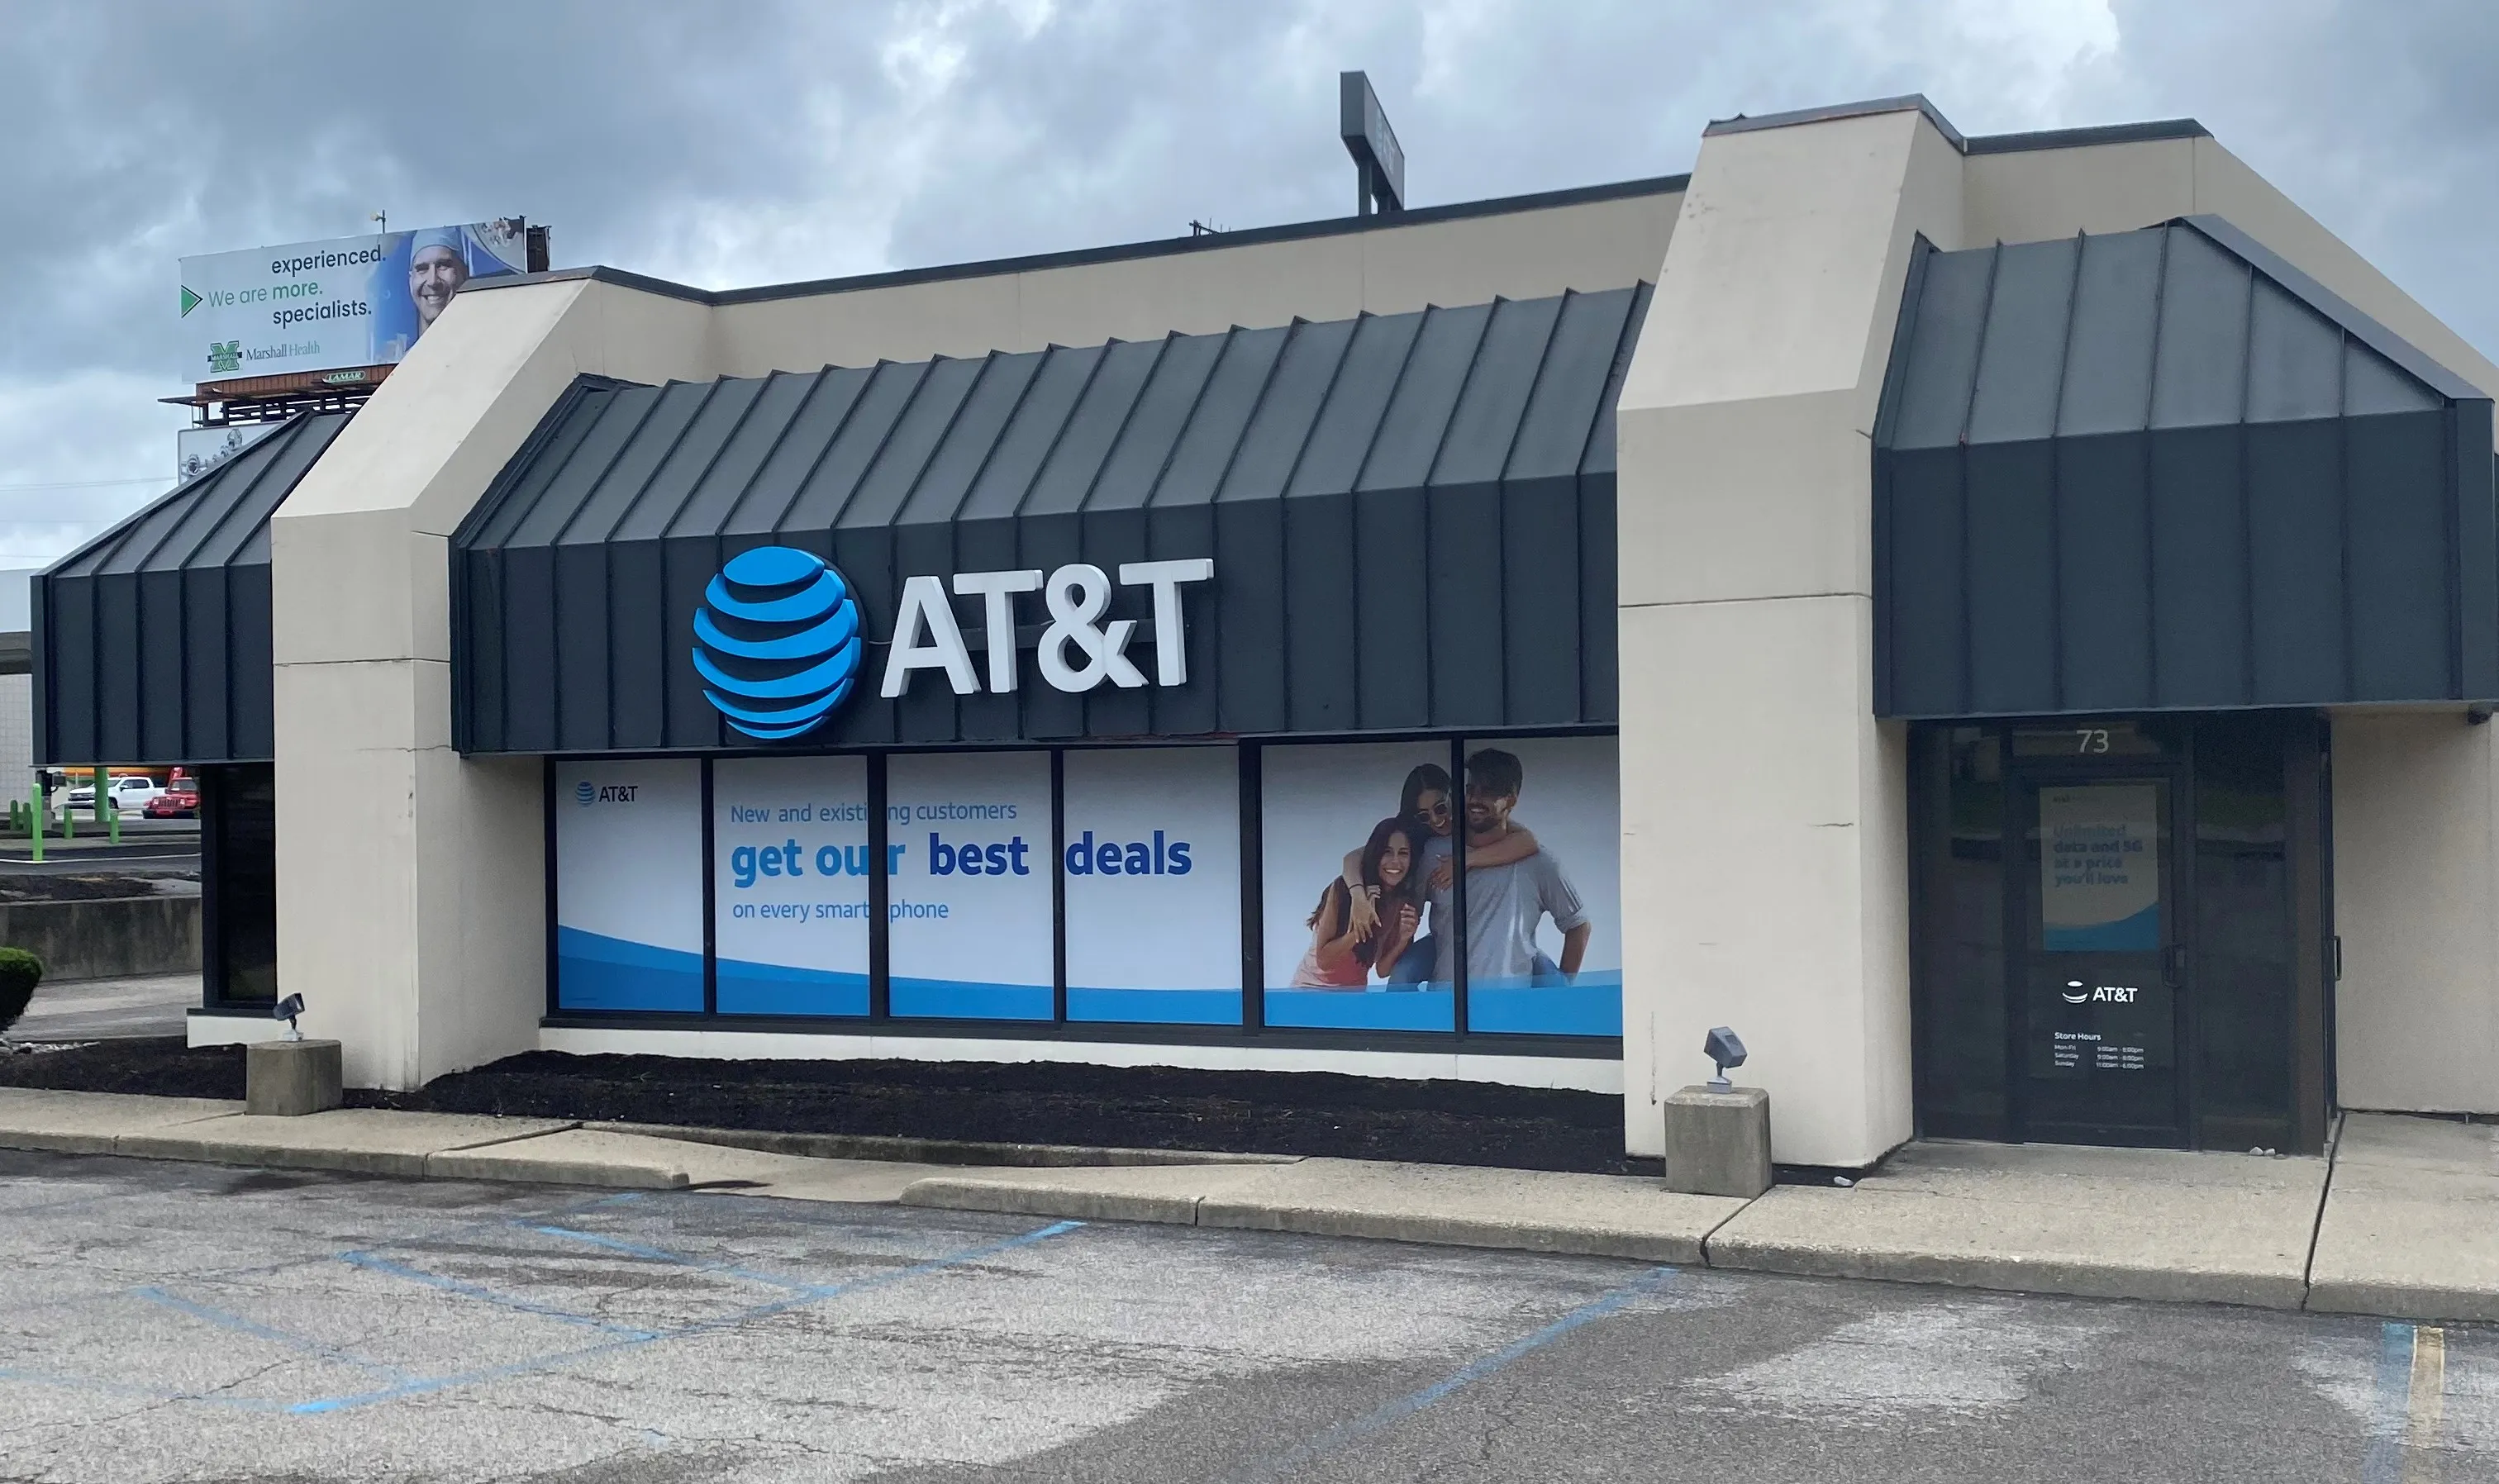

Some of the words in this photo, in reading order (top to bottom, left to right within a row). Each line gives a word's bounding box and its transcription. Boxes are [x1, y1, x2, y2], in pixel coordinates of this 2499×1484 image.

[271, 245, 387, 278] experienced.
[208, 290, 235, 307] We
[240, 288, 268, 303] are
[272, 281, 323, 300] more.
[273, 299, 372, 329] specialists.
[246, 344, 287, 361] Marshall
[290, 340, 321, 357] Health
[329, 372, 362, 382] LAMAR
[881, 558, 1214, 698] AT&T
[2076, 730, 2109, 753] 73
[598, 785, 638, 803] AT&T
[731, 805, 769, 822] New
[778, 802, 812, 821] and
[916, 802, 1017, 820] customers
[731, 839, 803, 887] get
[930, 832, 1030, 876] best
[1065, 830, 1192, 876] deals
[733, 904, 754, 919] on
[760, 902, 810, 923] every
[2092, 987, 2138, 1003] AT&T
[2054, 1032, 2076, 1040] Store
[2078, 1033, 2102, 1041] Hours
